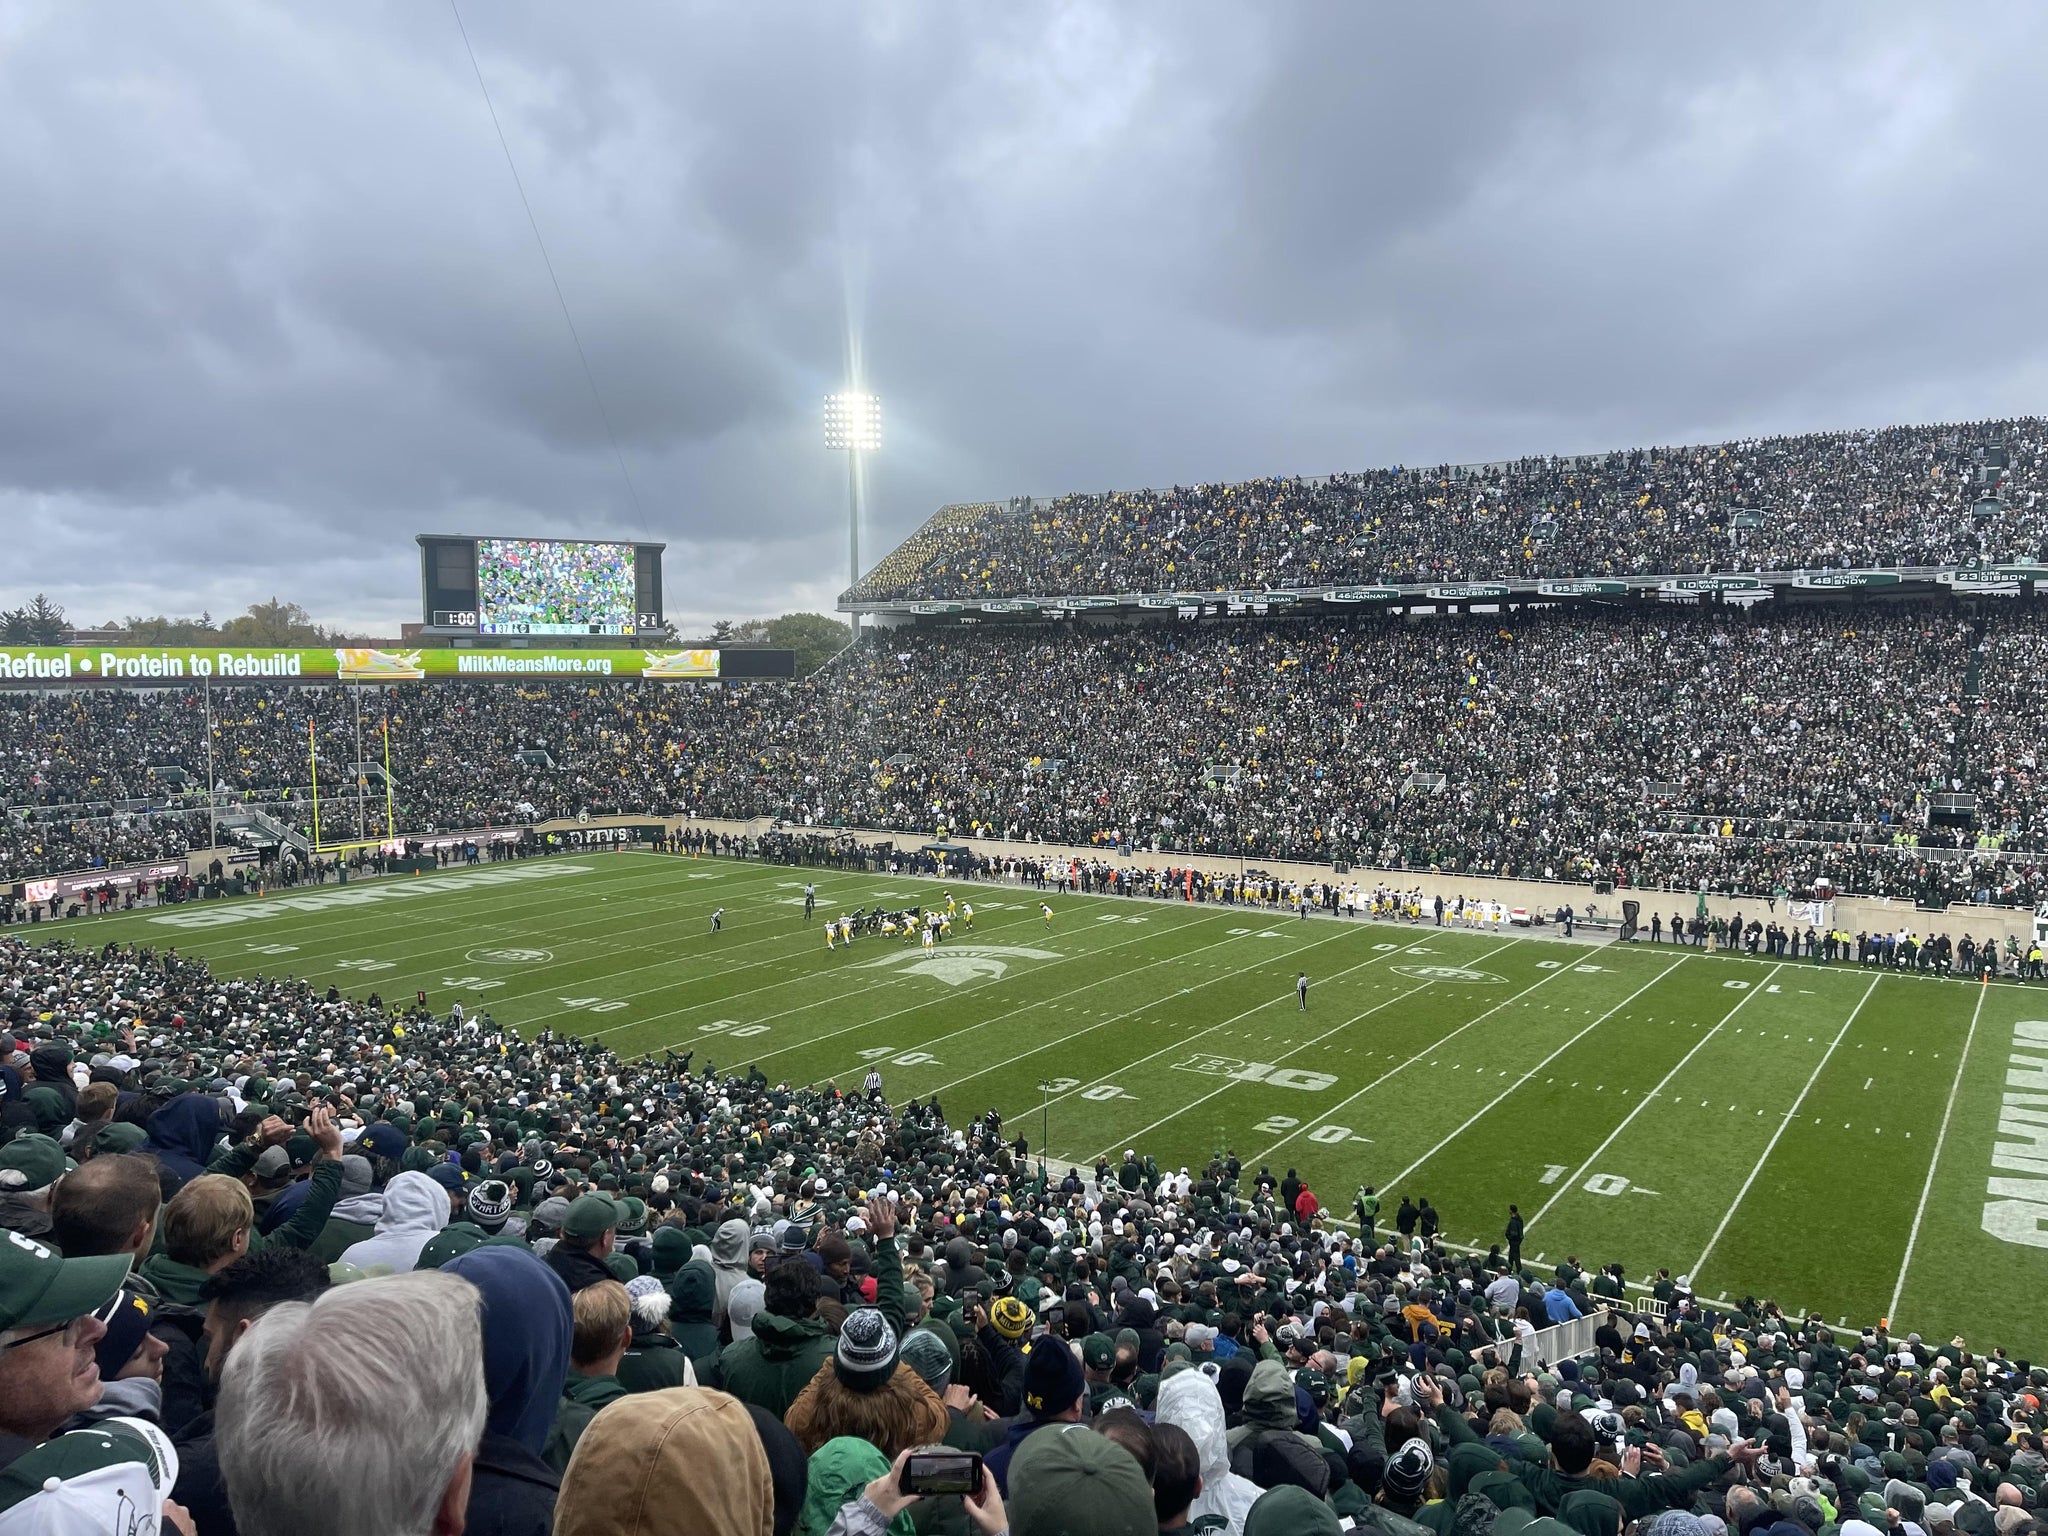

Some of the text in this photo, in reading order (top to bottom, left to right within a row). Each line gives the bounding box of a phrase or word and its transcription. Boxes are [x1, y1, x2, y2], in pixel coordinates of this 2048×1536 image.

[1813, 577, 1831, 585] 48
[1960, 573, 1978, 581] 23
[449, 612, 476, 626] 1:00
[639, 614, 656, 627] 21
[500, 625, 509, 633] 37
[610, 625, 620, 634] 33
[0, 653, 300, 678] Refuel Protein to Rebuild
[458, 655, 612, 675] MilkMeansMore.org
[147, 864, 594, 928] SPARTANS
[698, 1019, 771, 1037] 50
[1252, 1115, 1353, 1144] 20
[1538, 1164, 1631, 1196] 10
[9, 1231, 51, 1259] S
